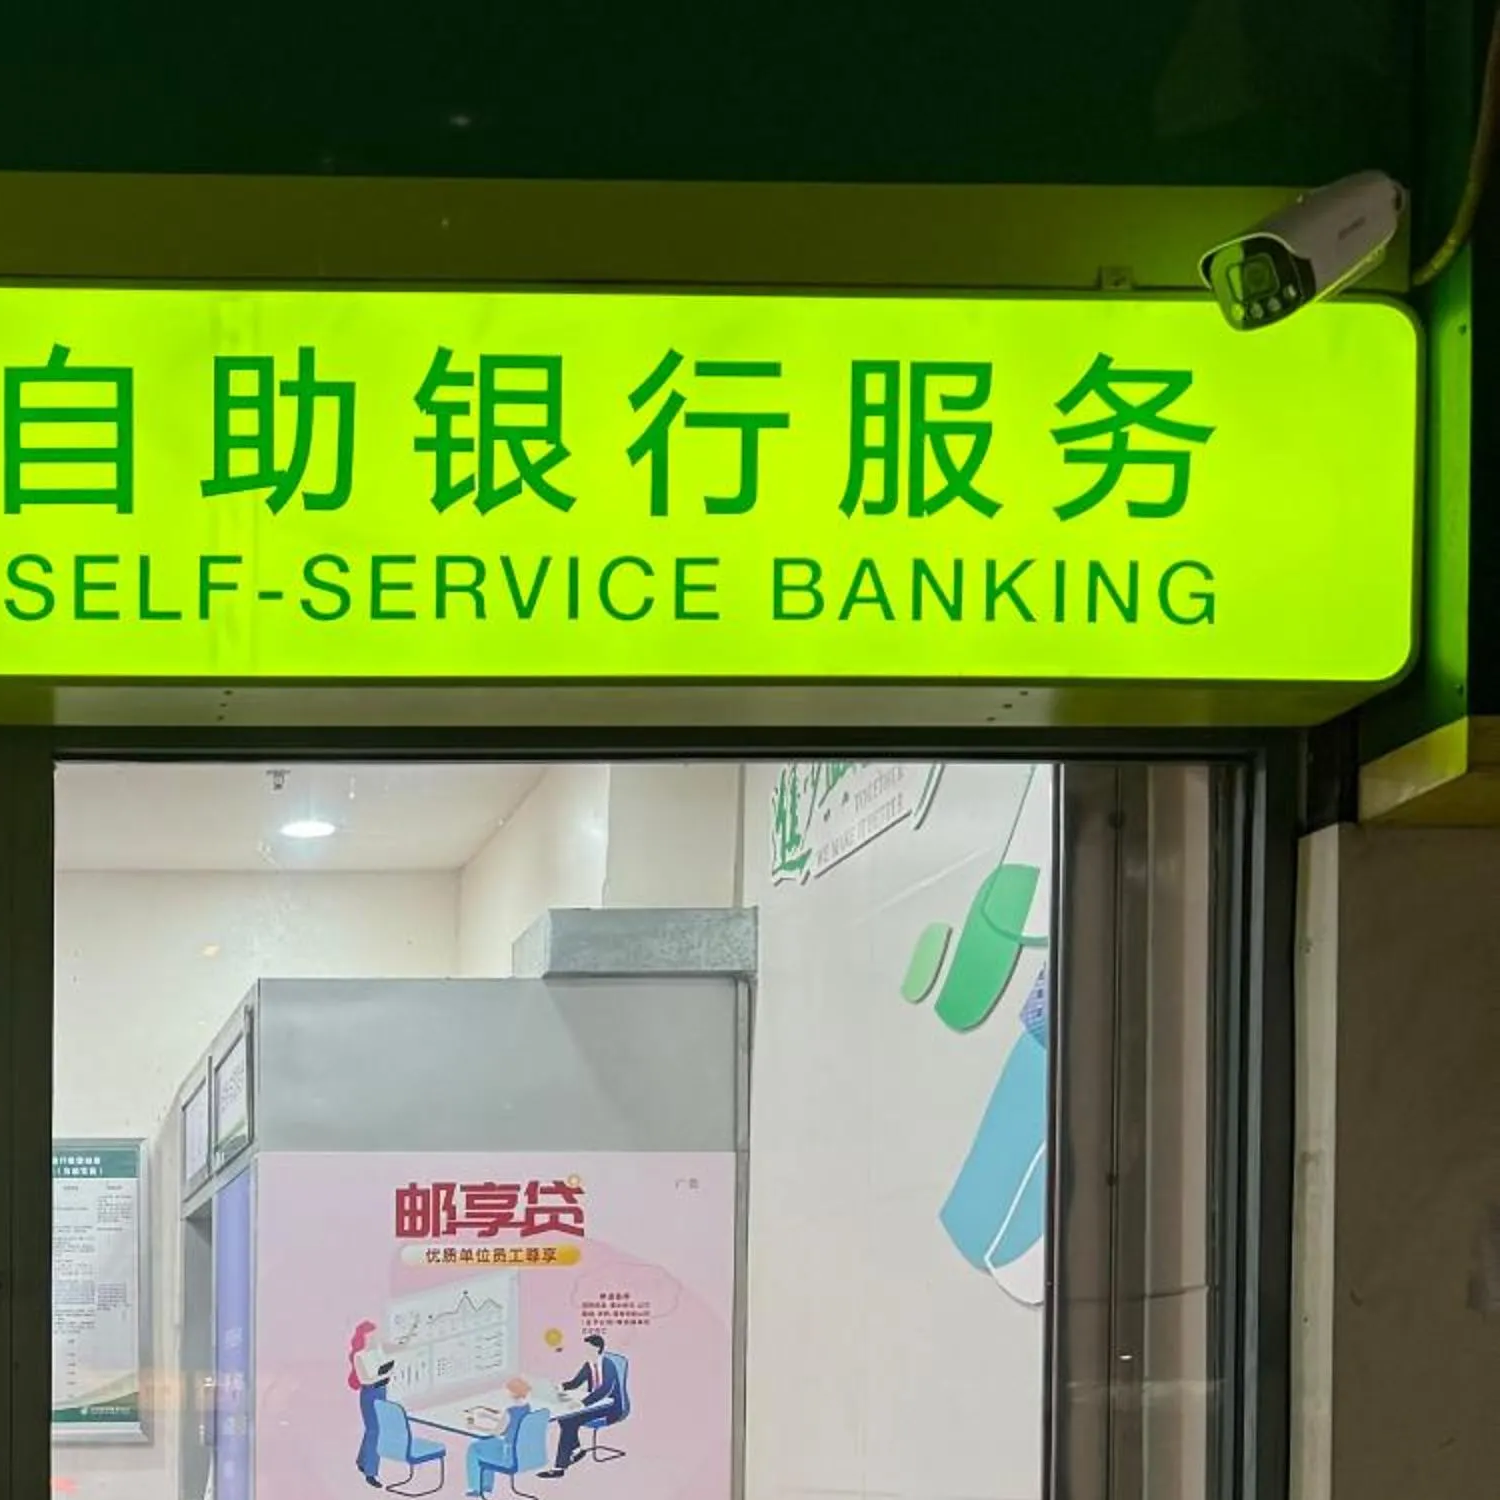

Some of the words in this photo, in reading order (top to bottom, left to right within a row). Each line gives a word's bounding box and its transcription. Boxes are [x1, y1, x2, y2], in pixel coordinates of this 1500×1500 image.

[2, 344, 1217, 521] 自助银行服务
[4, 553, 720, 623] SELF-SERVICE
[772, 557, 1217, 626] BANKING
[395, 1180, 586, 1238] 邮享贷
[425, 1247, 557, 1264] 优质单位员工尊享
